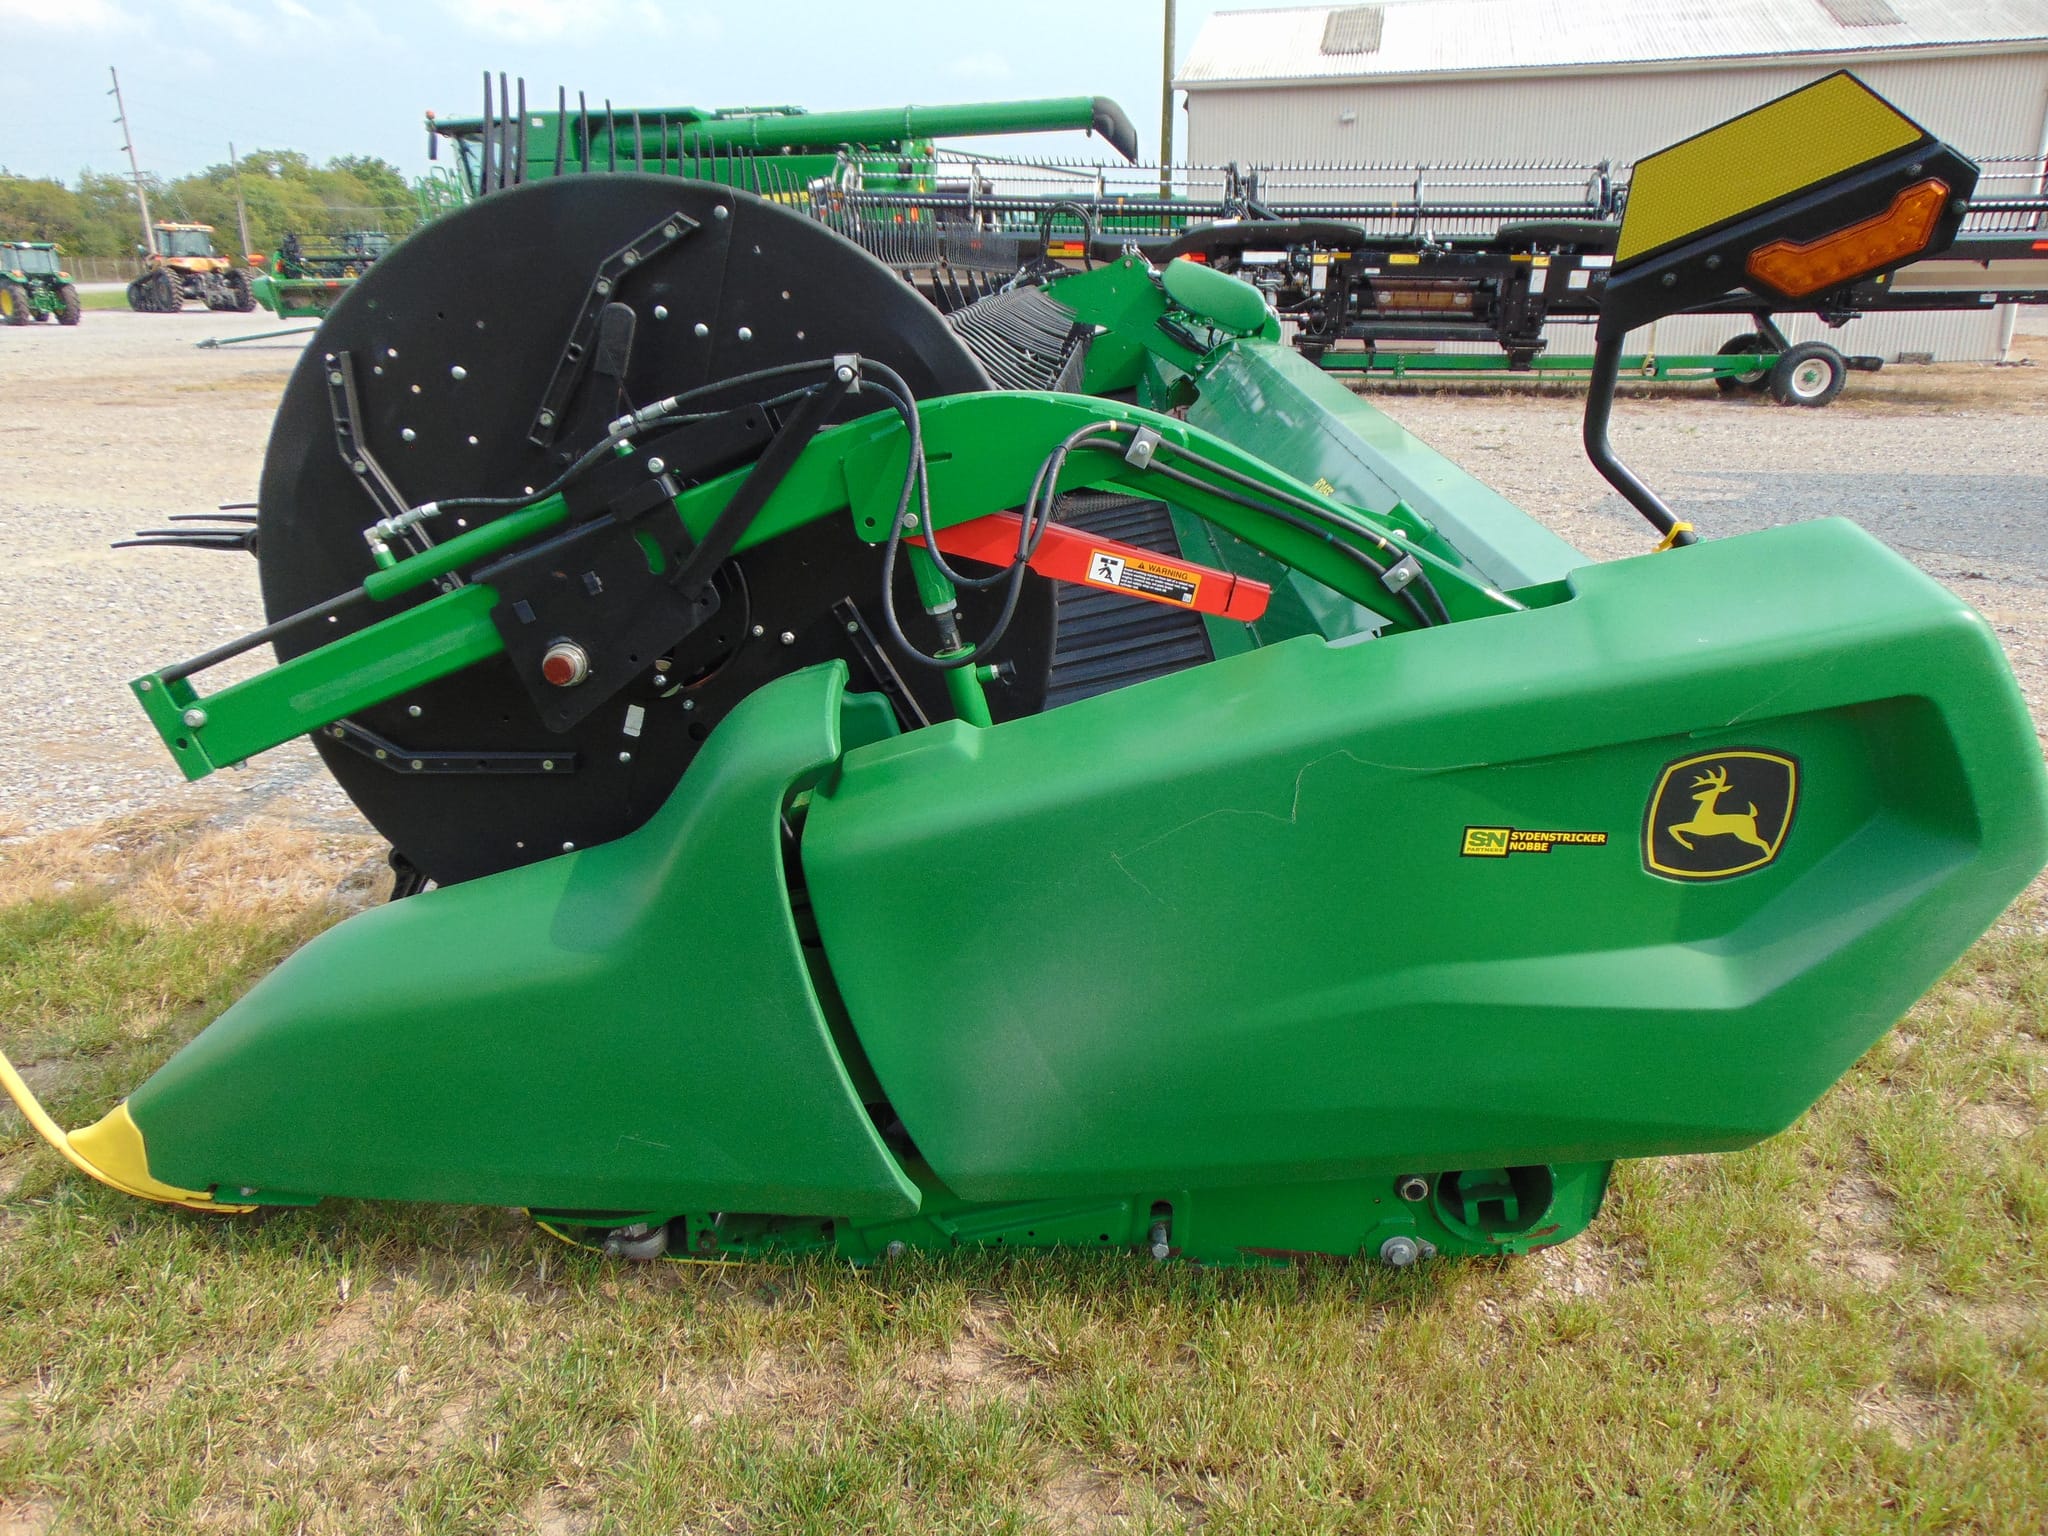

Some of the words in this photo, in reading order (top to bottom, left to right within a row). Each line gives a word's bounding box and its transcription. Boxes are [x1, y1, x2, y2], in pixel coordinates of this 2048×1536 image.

[1148, 564, 1188, 580] WARNING
[1468, 831, 1506, 847] SN
[1510, 832, 1606, 843] SYDENSTRICKER
[1509, 841, 1549, 851] NOBBE
